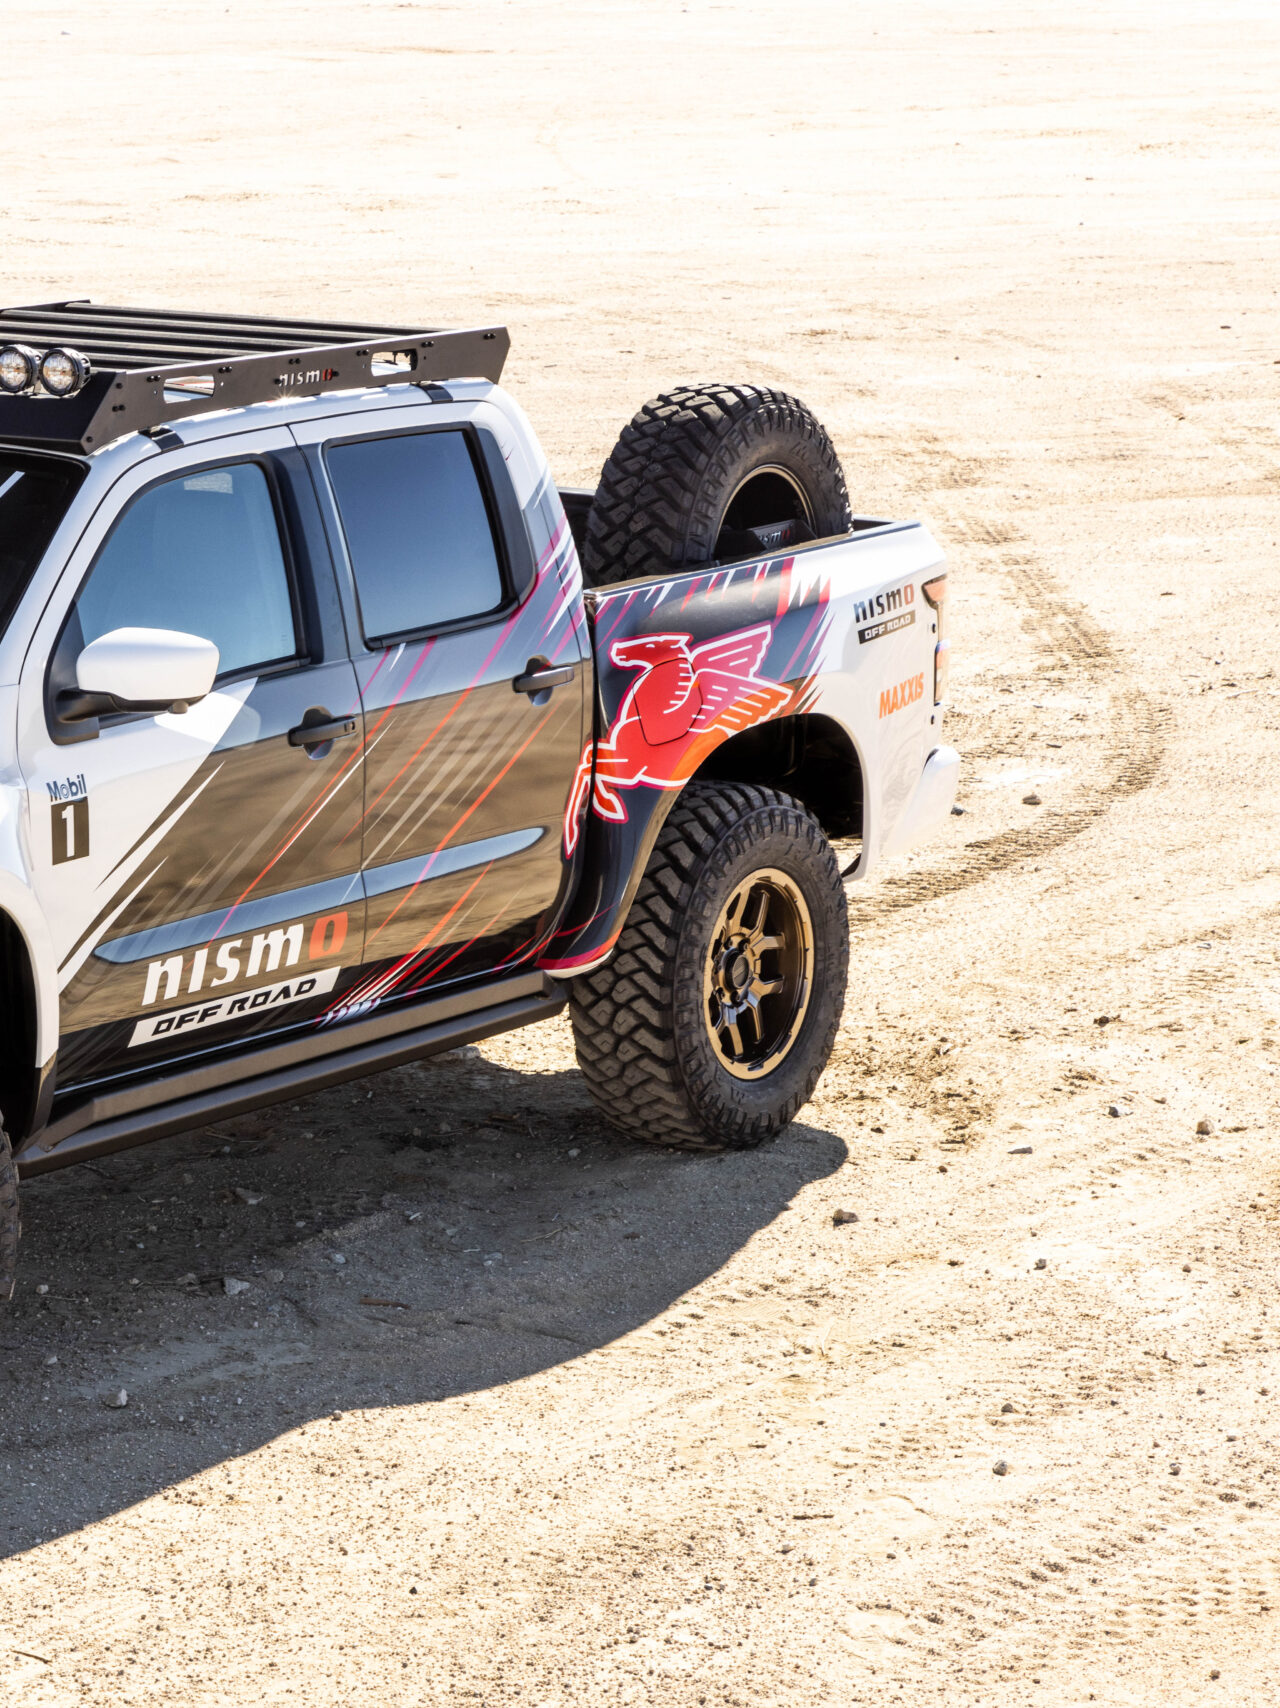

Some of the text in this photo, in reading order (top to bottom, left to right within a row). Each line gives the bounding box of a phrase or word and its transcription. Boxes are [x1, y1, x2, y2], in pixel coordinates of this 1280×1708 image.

[853, 584, 915, 623] nismo
[864, 614, 911, 640] OFF ROAD
[879, 672, 924, 720] MAXXIS
[46, 773, 87, 802] Mobil
[141, 911, 348, 1006] nismo
[151, 977, 318, 1037] OFF ROAD
